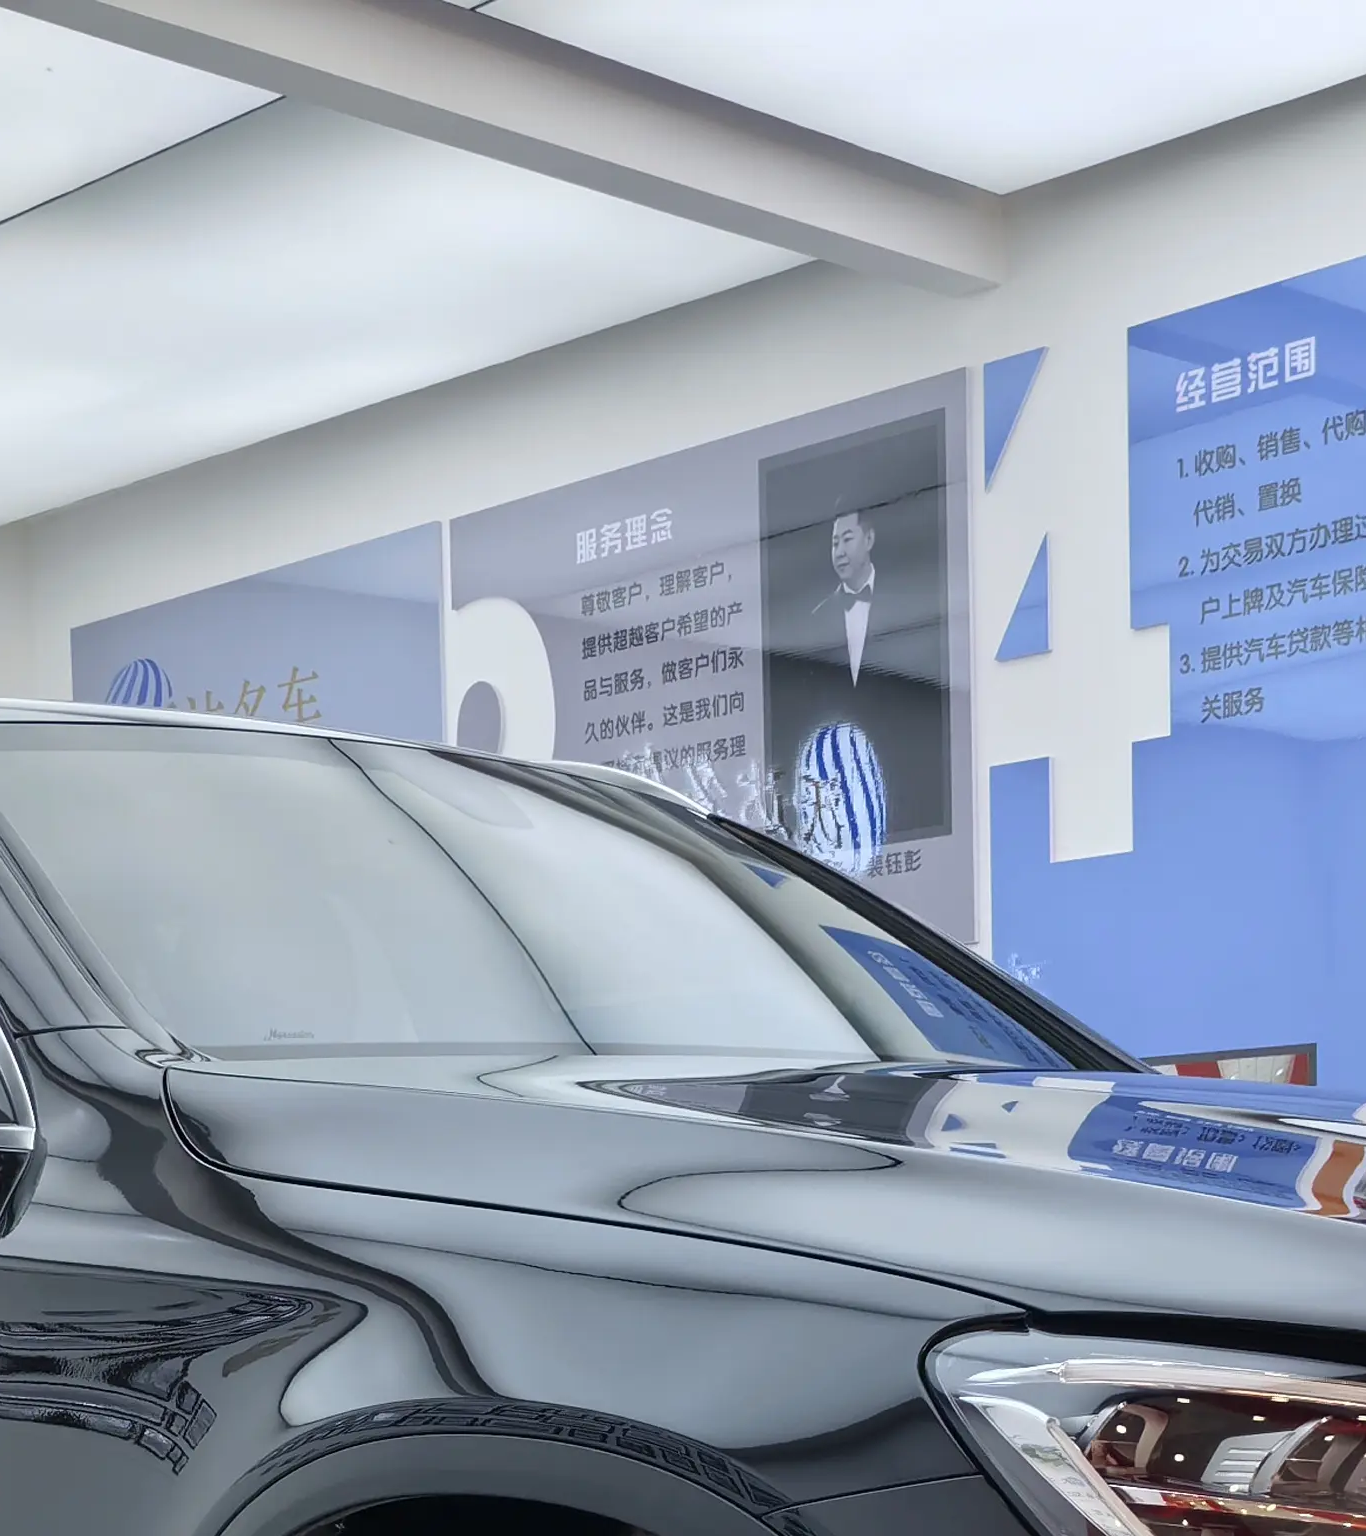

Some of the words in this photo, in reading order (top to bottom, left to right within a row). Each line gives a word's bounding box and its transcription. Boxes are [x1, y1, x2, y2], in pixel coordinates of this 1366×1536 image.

[1176, 336, 1316, 413] 经营范围
[1193, 477, 1302, 527] 代销、置换
[576, 507, 673, 564] 服务理念
[982, 328, 1171, 864] 4
[581, 601, 744, 660] 提供超越客户希望的产
[583, 646, 744, 701] 品与服务，做客户们永
[585, 690, 745, 745] 久的伙伴。这是我们向
[1201, 687, 1265, 724] 关服务
